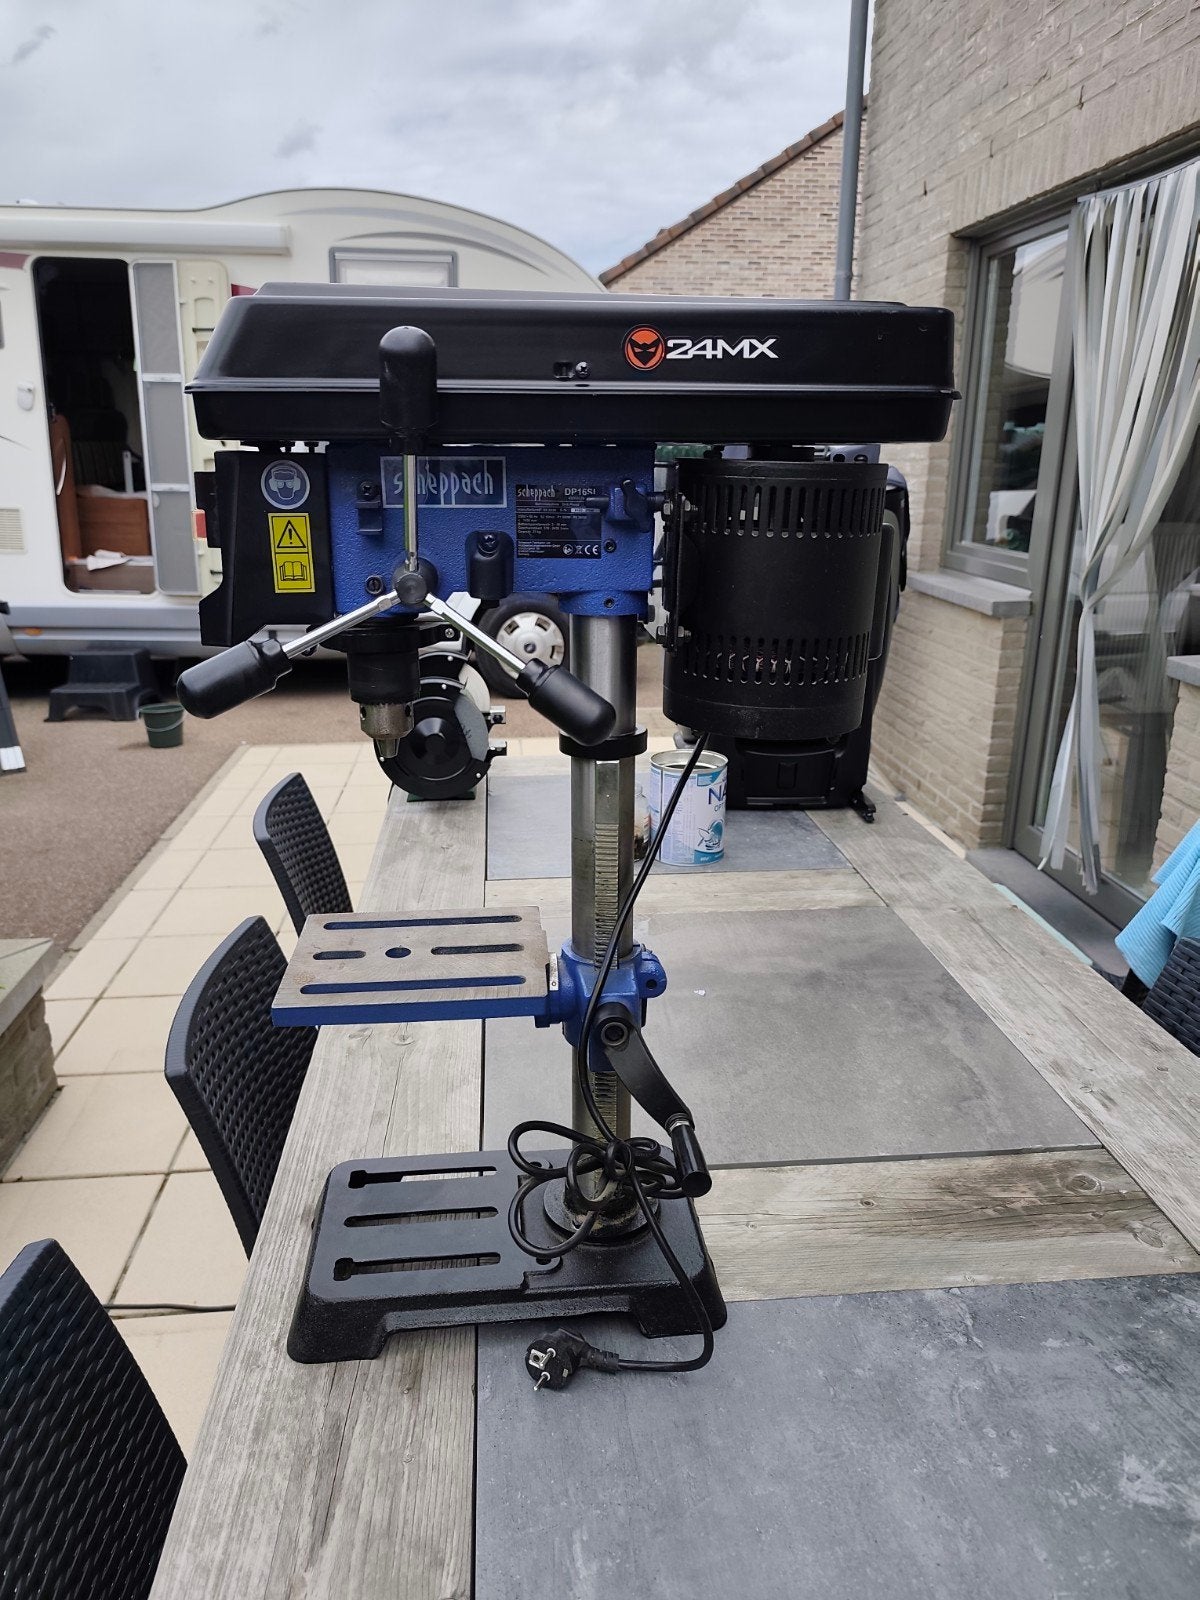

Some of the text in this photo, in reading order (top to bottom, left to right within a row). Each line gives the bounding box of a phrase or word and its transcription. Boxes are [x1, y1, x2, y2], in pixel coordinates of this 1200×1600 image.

[665, 338, 779, 359] 24MX
[394, 459, 494, 505] sheppach
[517, 485, 556, 501] scheppach
